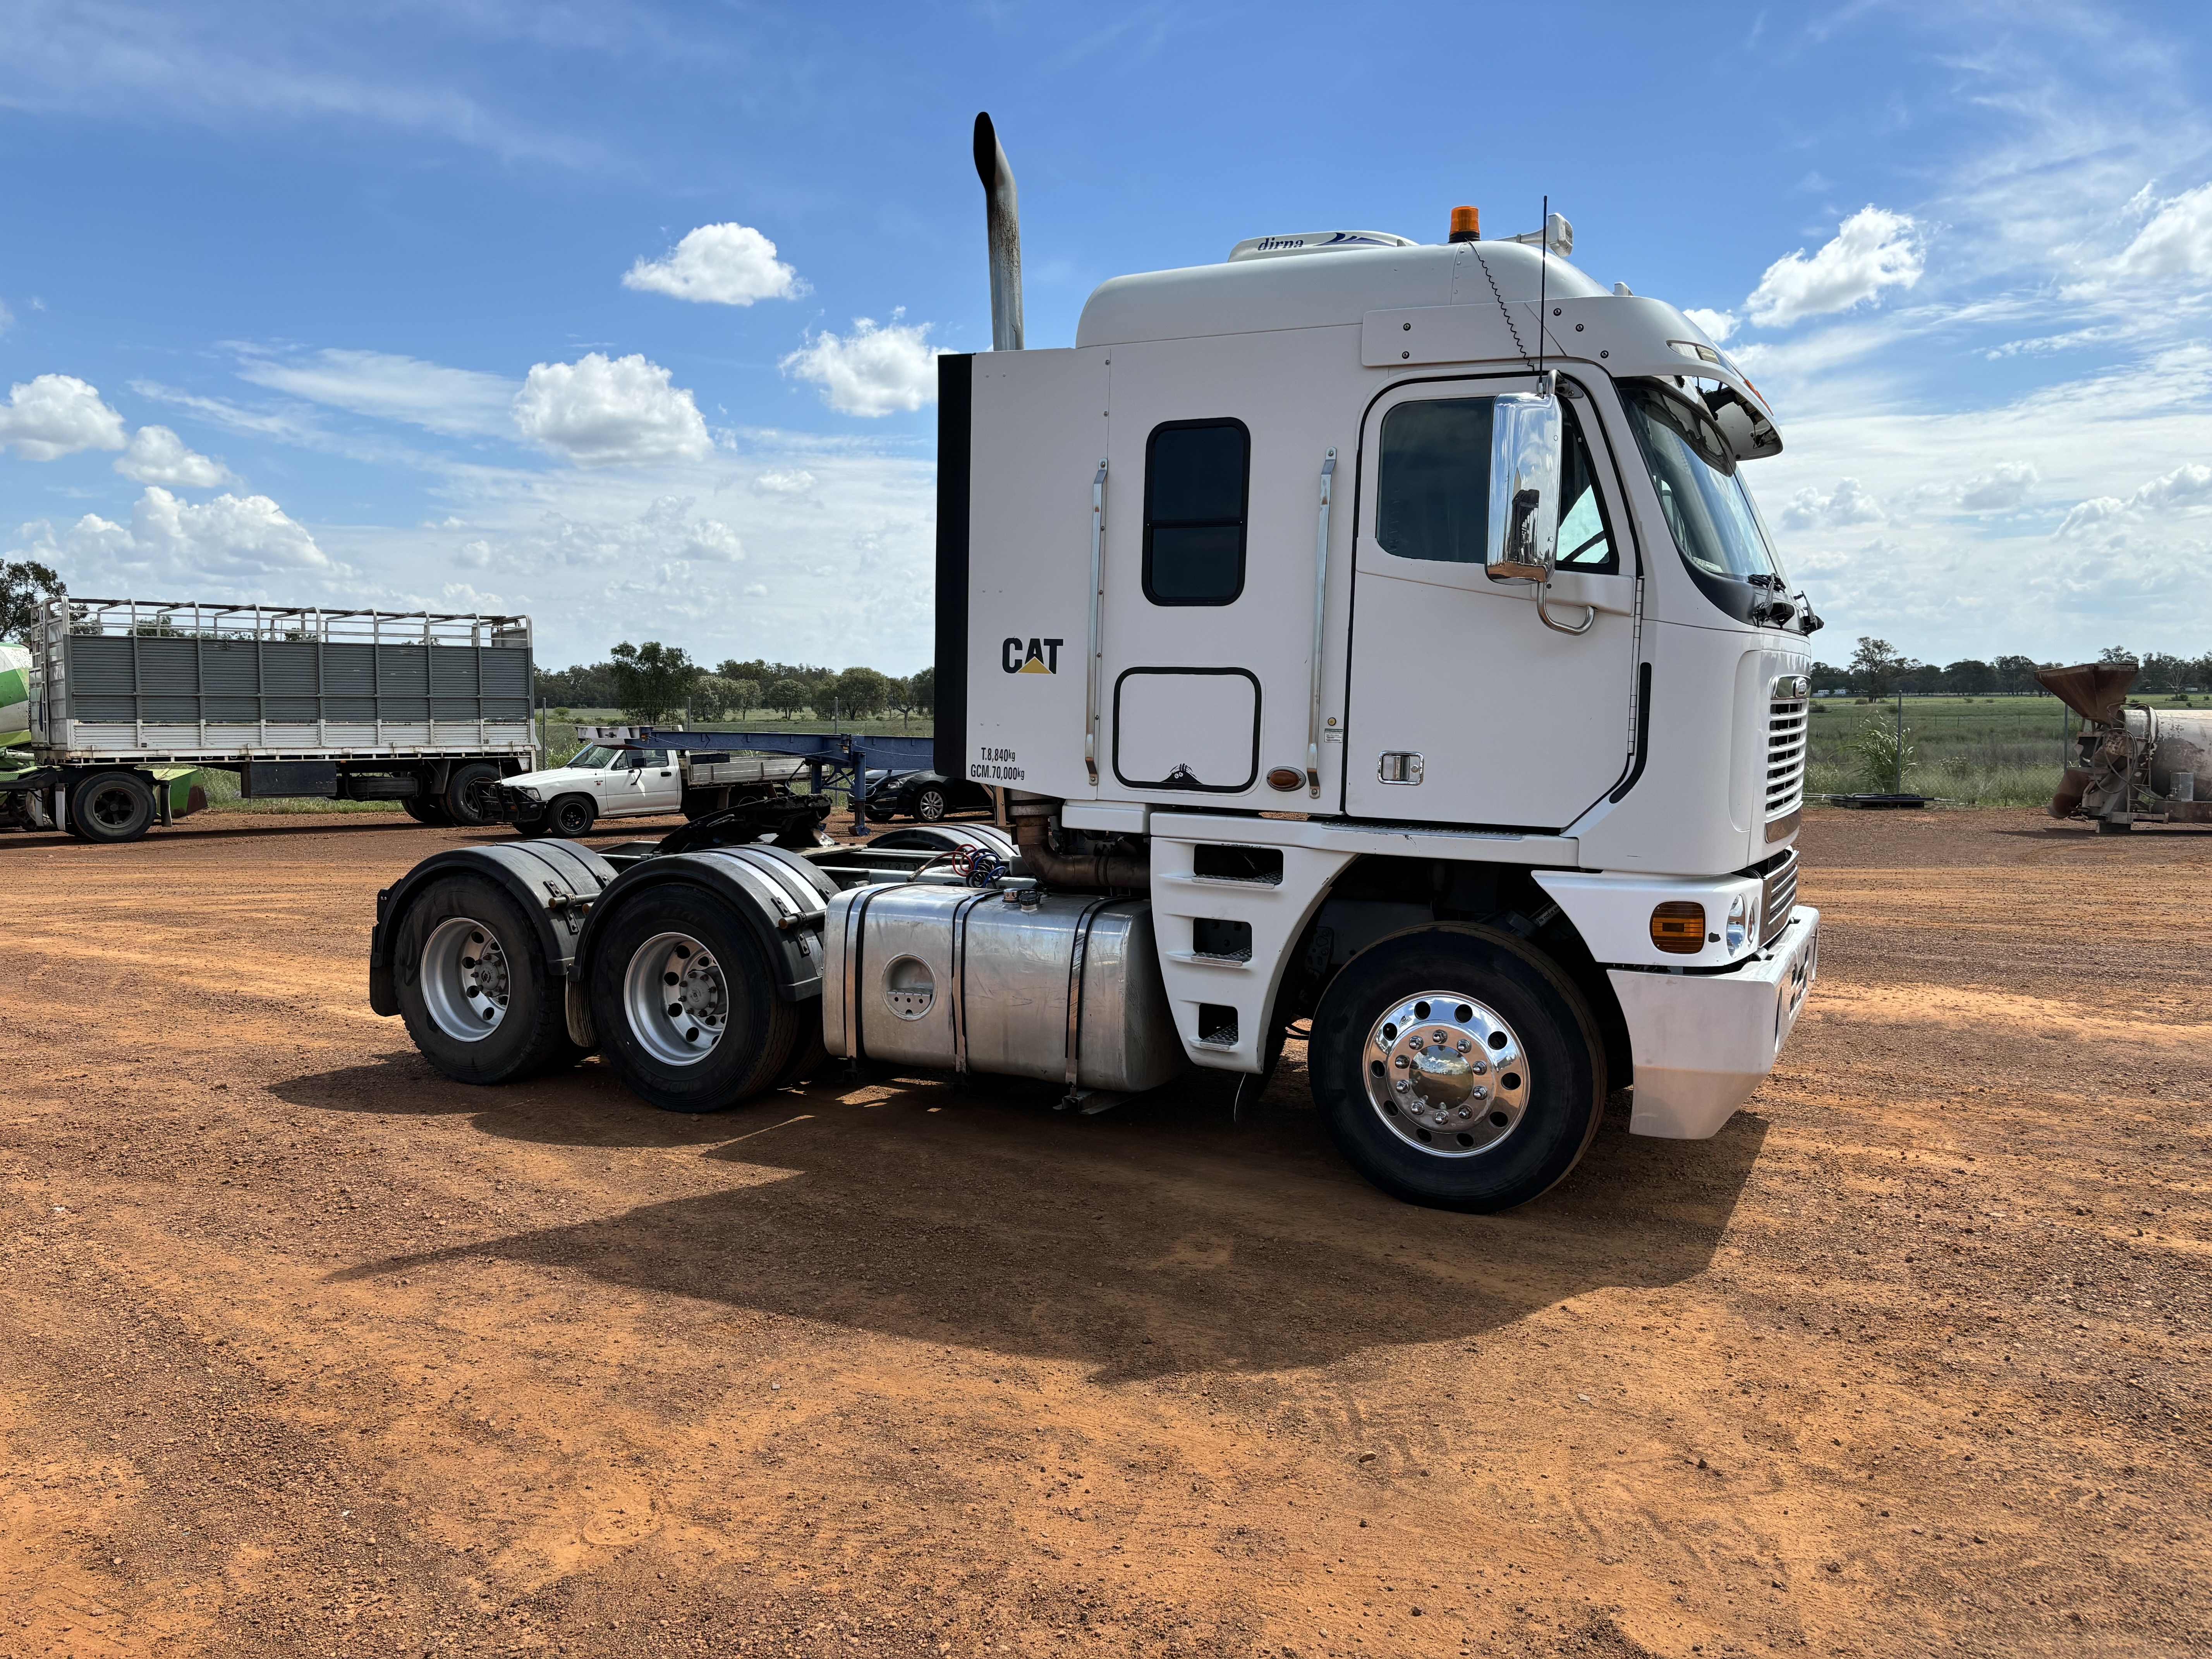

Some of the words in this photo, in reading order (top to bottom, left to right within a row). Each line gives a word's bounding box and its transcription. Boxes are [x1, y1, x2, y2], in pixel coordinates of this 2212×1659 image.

[1257, 237, 1304, 251] dirna
[1002, 637, 1063, 674] CAT
[981, 747, 1015, 763] T.8,840kg
[971, 764, 1025, 781] GCM.70,000kg
